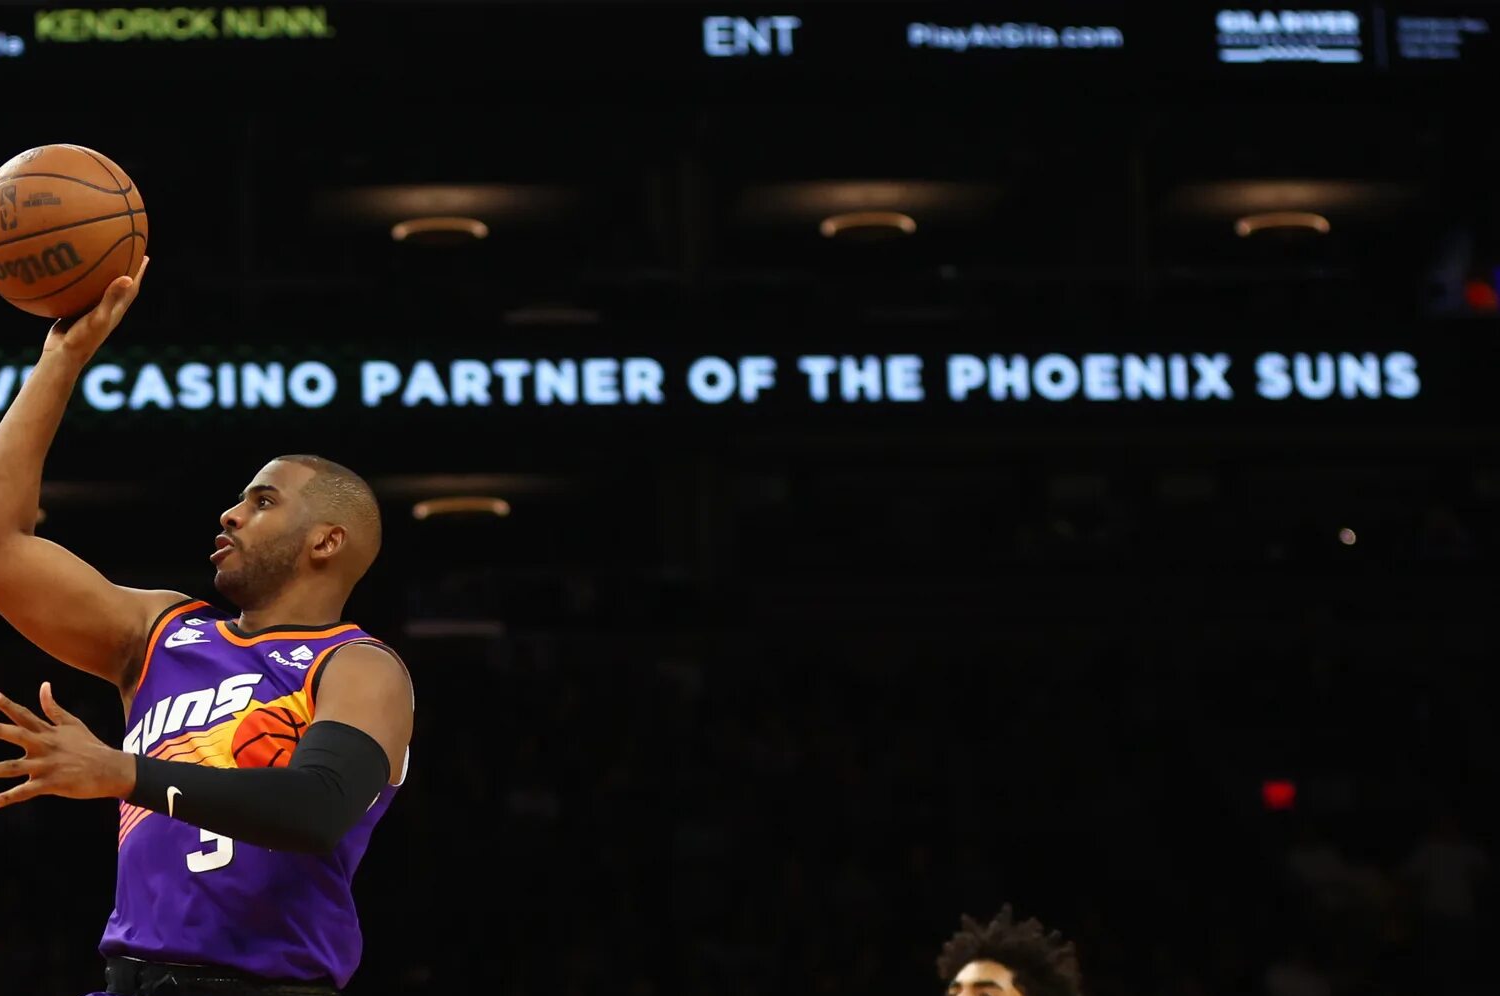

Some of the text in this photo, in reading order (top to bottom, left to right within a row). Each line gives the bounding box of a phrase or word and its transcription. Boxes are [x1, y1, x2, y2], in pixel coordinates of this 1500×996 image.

[34, 9, 218, 42] KENDRICK
[703, 16, 800, 56] ENT
[83, 361, 337, 409] CASINO
[360, 359, 665, 407] PARTNER
[687, 356, 777, 404] OF
[798, 355, 926, 403] THE
[946, 353, 1234, 402] PHOENIX
[1255, 352, 1421, 400] SUNS
